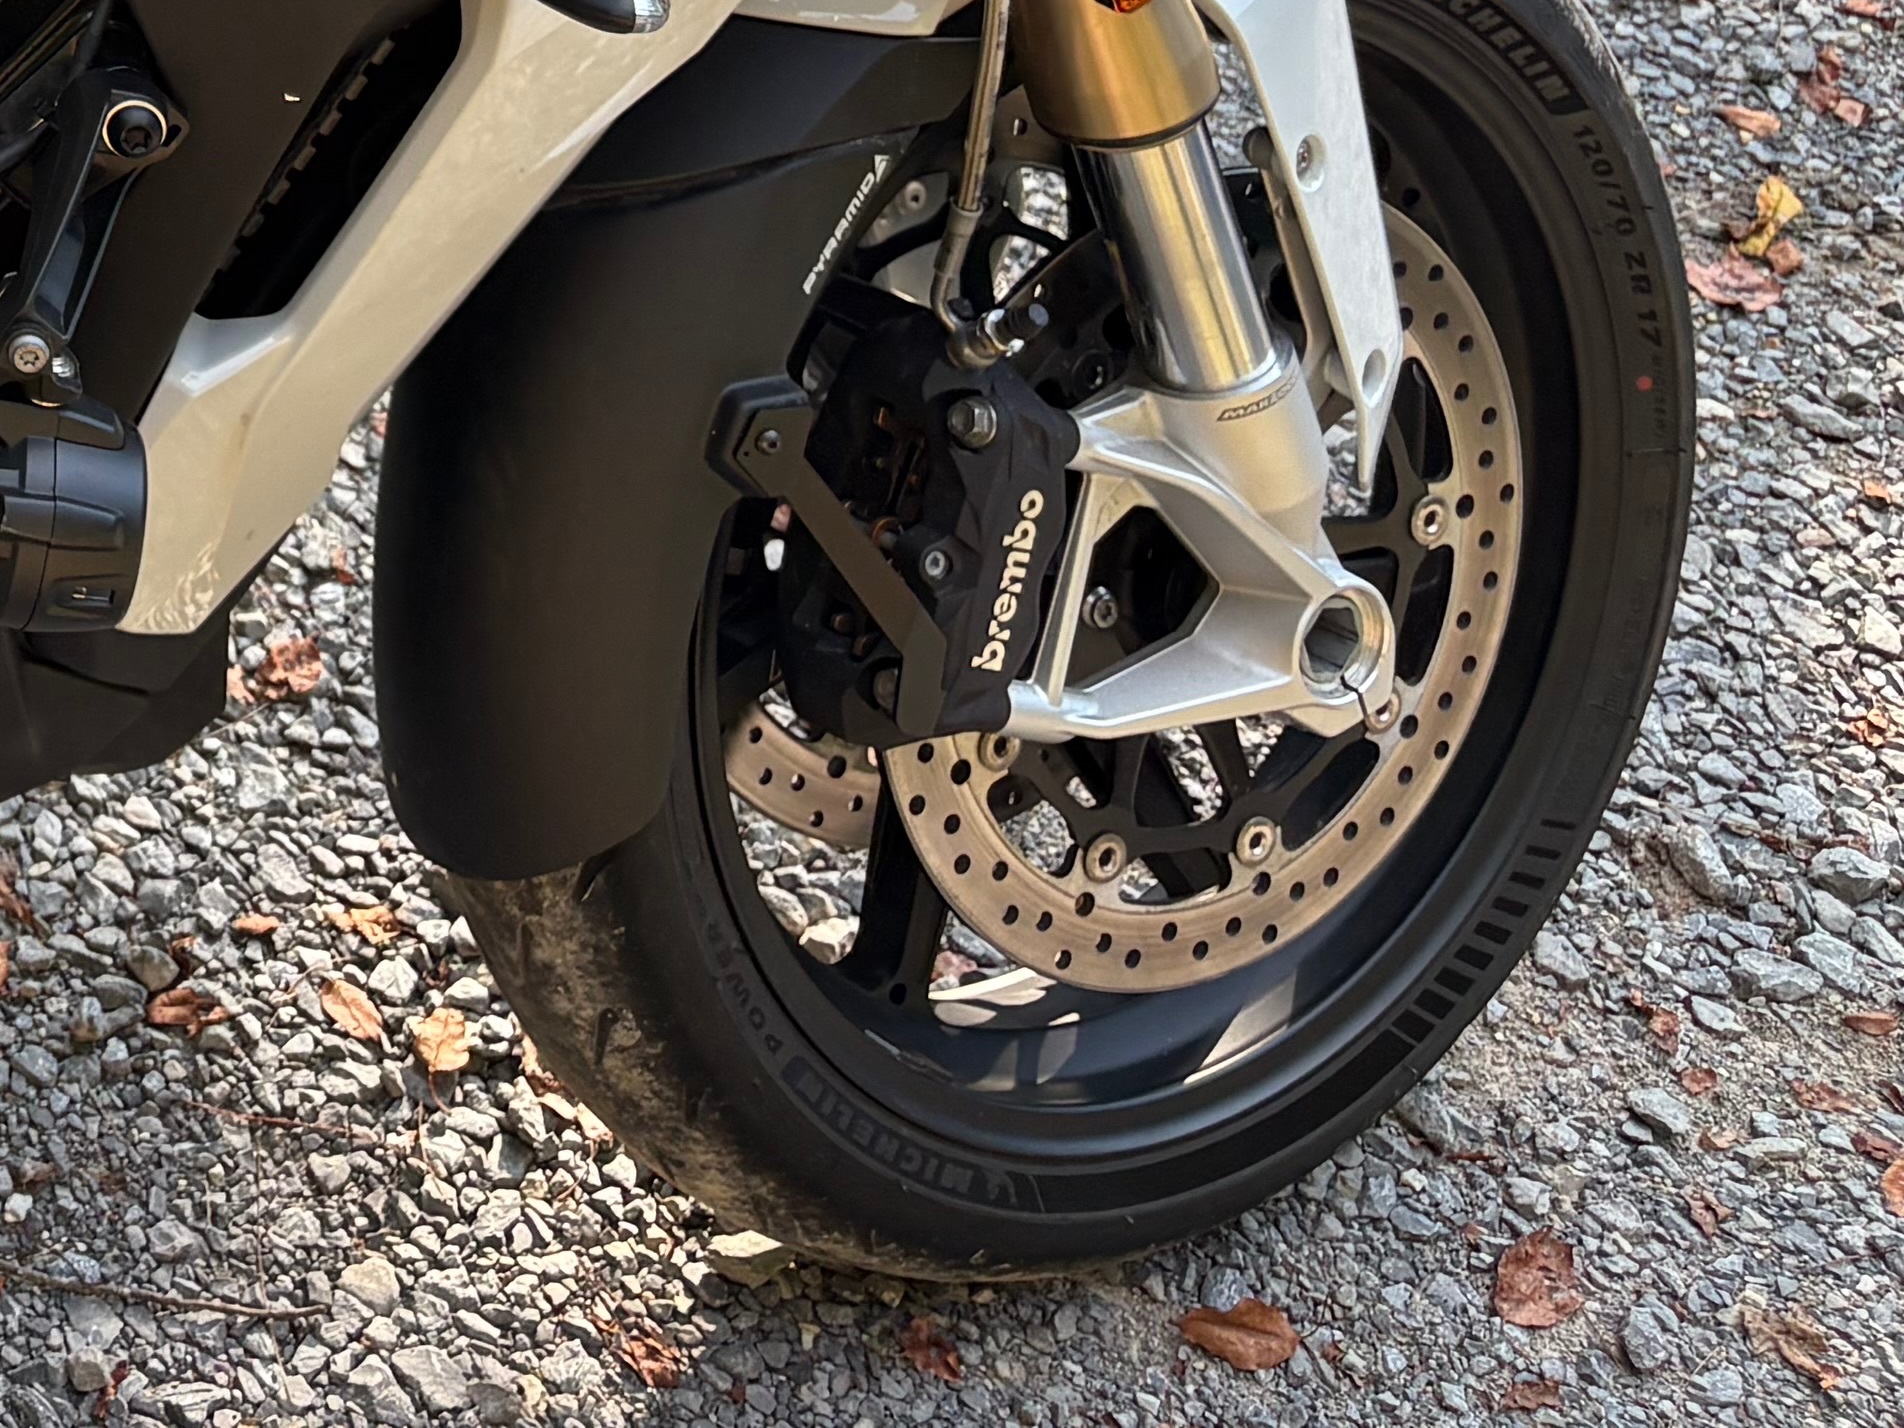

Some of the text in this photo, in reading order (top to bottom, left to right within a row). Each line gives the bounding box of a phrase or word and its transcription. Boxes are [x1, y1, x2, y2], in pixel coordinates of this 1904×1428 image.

[1573, 124, 1638, 239] 120/70
[1623, 251, 1654, 296] ZR
[1636, 307, 1663, 349] 17
[971, 489, 1044, 672] brembo
[796, 1072, 975, 1194] MICHELIN
